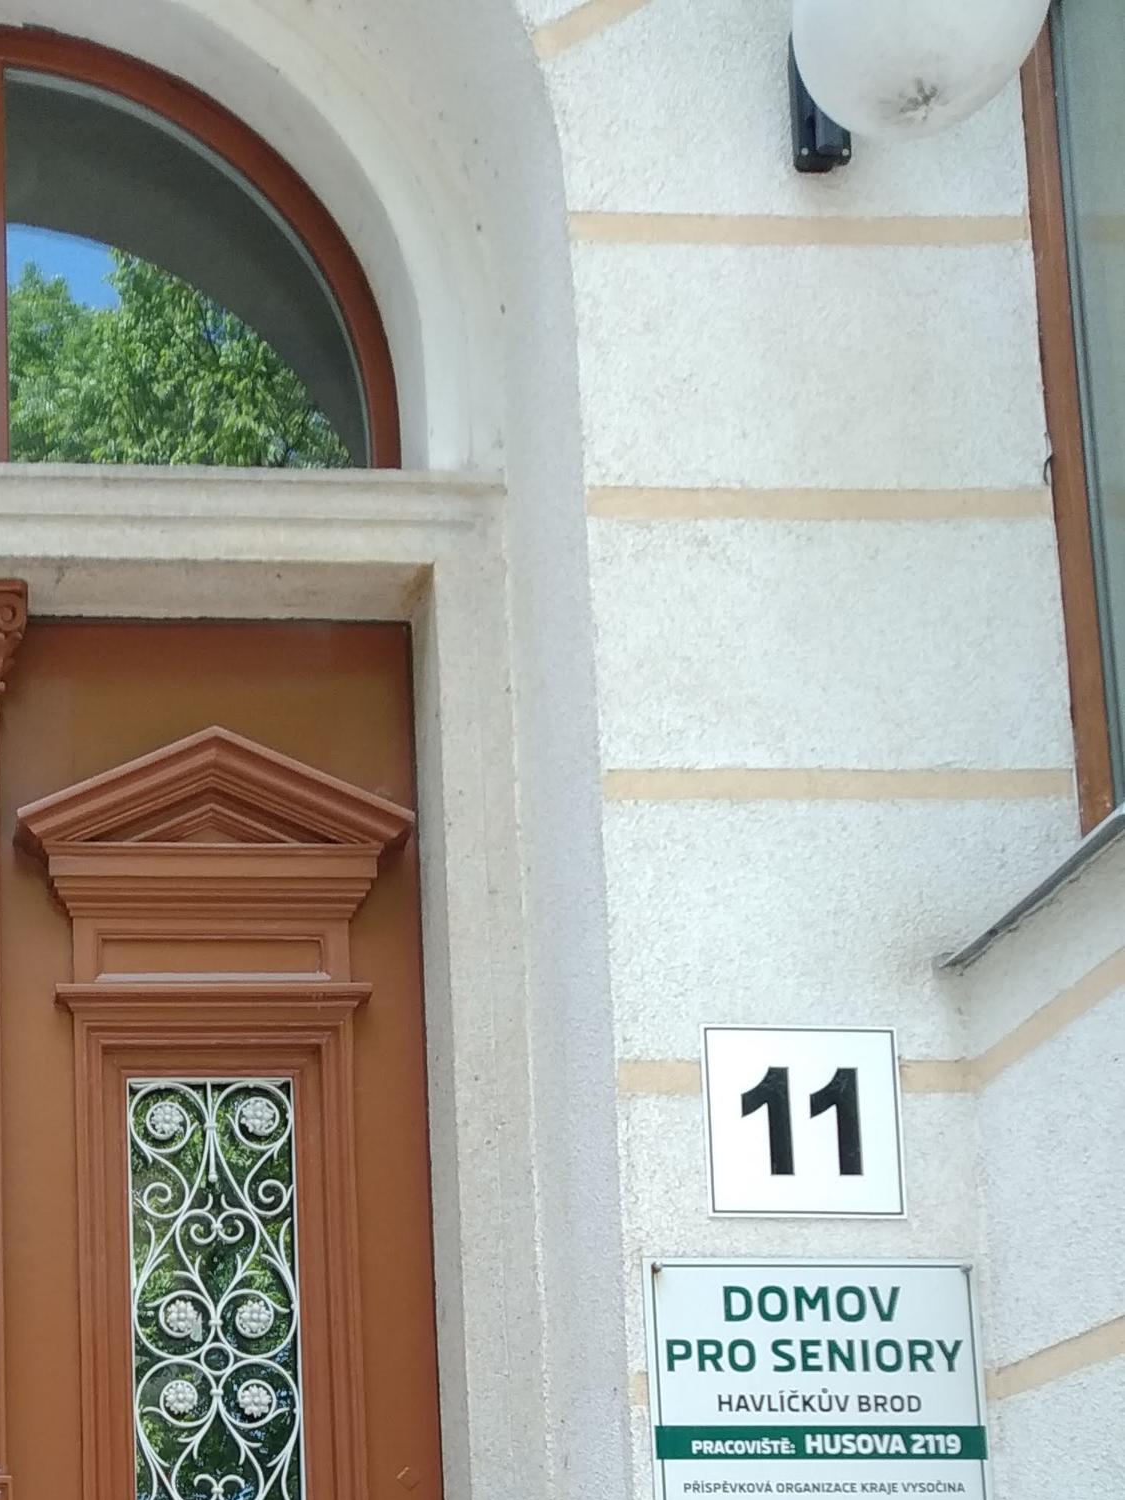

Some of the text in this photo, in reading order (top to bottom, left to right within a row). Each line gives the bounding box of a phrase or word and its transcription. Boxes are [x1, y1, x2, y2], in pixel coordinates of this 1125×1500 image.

[740, 1066, 864, 1176] 11
[722, 1285, 901, 1322] DOMOV
[665, 1338, 963, 1373] PRO SENIORY
[717, 1388, 922, 1413] HAVLÍČKŮV BROD
[691, 1433, 962, 1456] PRACOVIŠTĚ: HUSOVA 2119
[683, 1479, 965, 1495] PŘÍSPĚVKOVÁ ORGANIZACE KRAJE VYSOČINA
